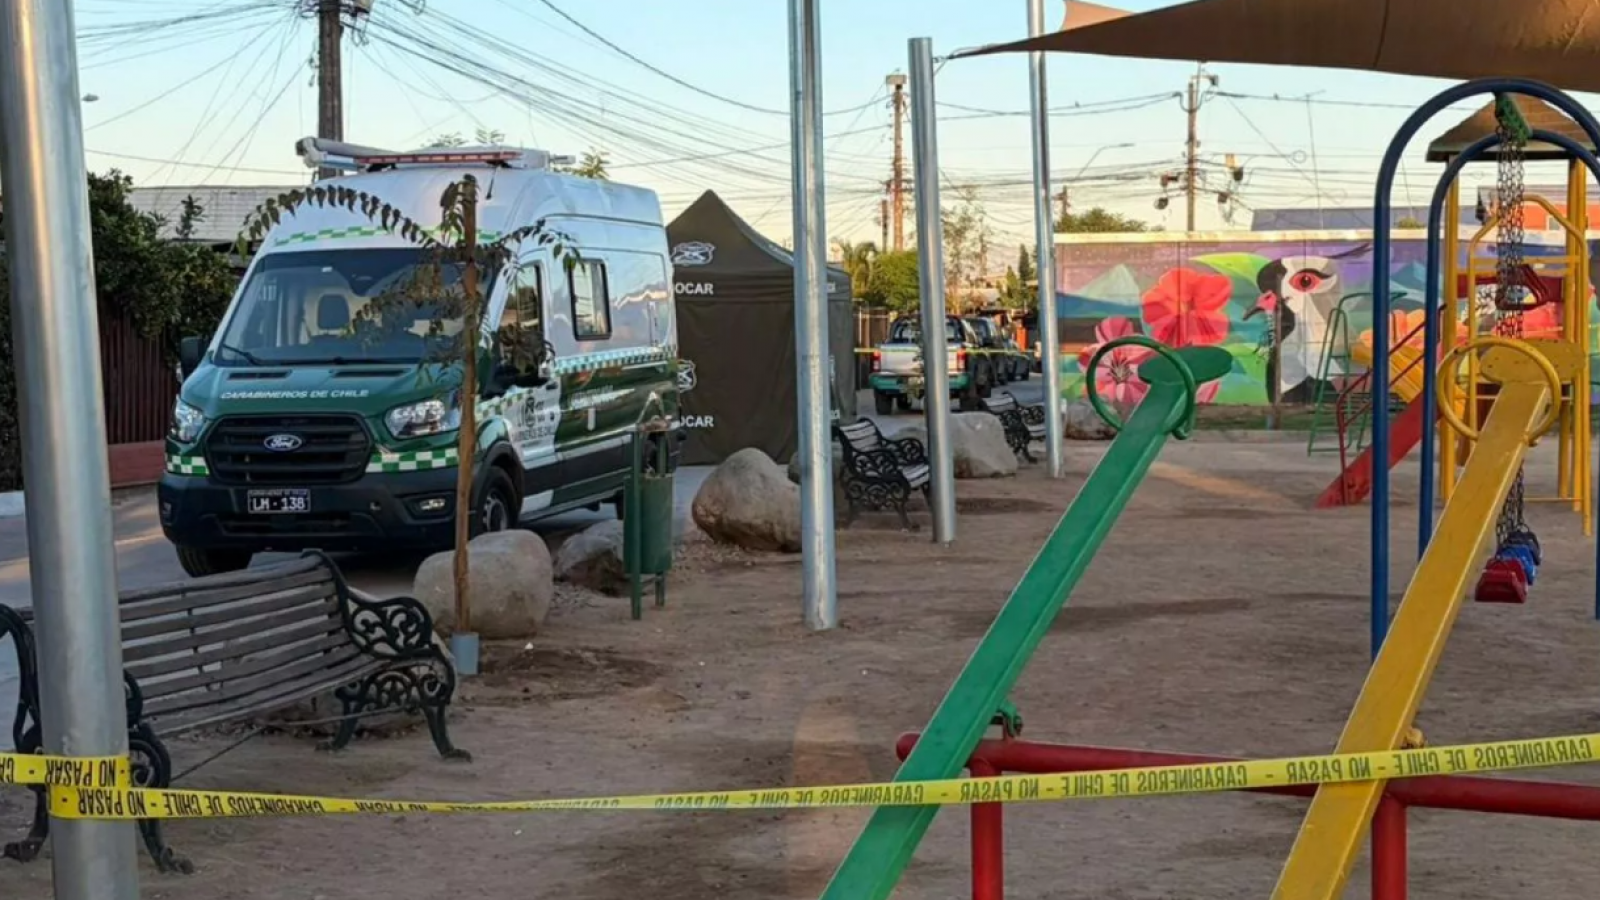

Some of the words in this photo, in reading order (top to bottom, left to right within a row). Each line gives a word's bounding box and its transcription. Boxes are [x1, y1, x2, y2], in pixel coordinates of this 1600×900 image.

[221, 389, 308, 399] CARABINEROS
[310, 389, 329, 399] DE
[331, 388, 370, 398] CHILE
[45, 757, 93, 787] PASAR
[99, 758, 117, 788] NO
[77, 788, 123, 815] PASAR
[126, 790, 147, 817] NO
[162, 792, 203, 816] CHILE
[204, 794, 222, 816] DE
